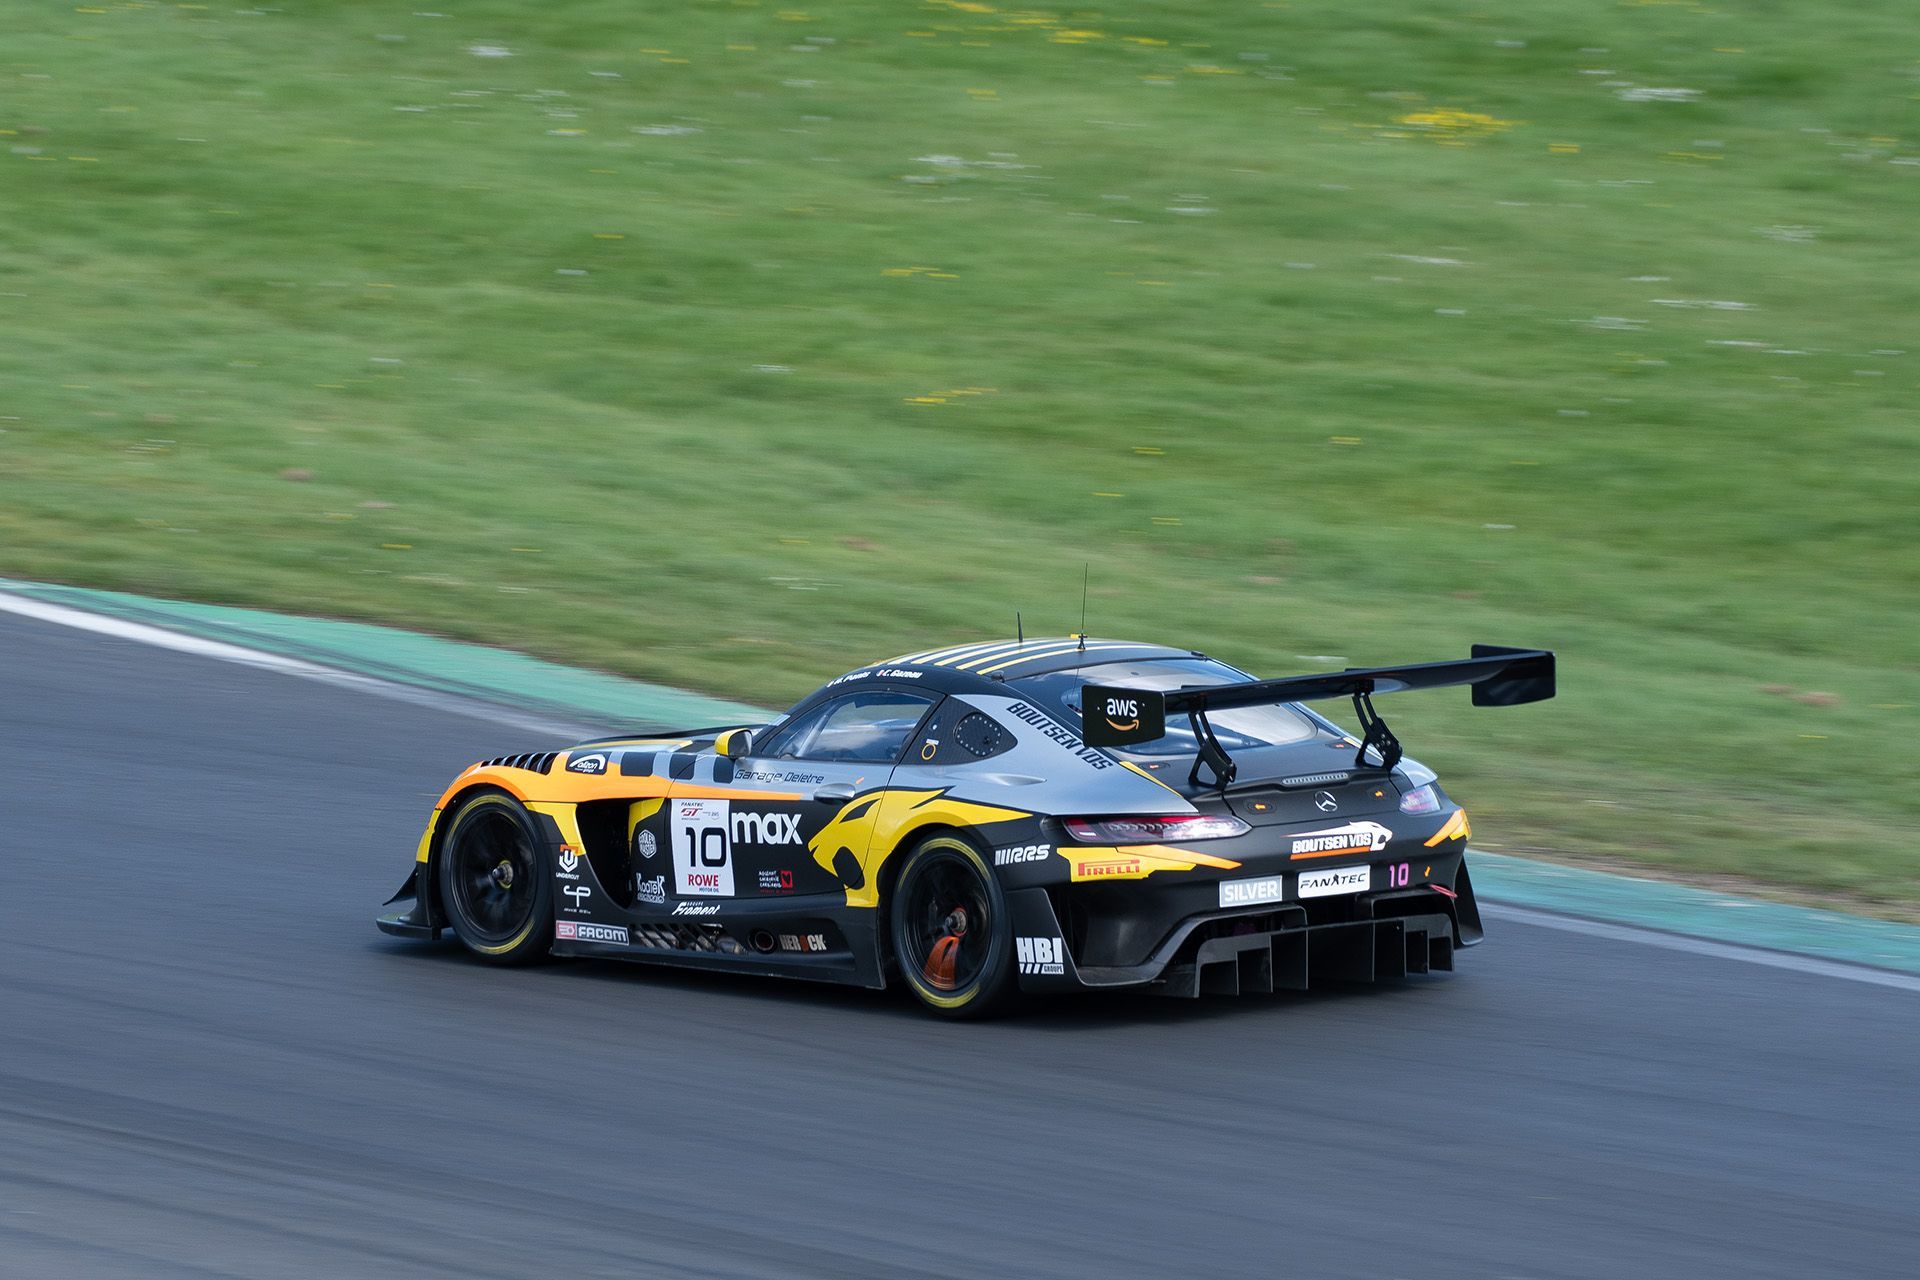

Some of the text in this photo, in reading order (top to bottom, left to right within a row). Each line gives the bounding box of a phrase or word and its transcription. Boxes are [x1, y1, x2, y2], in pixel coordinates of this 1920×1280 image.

[1106, 698, 1138, 717] aws
[1006, 701, 1113, 770] BOUTSEN VDS
[735, 770, 782, 783] Garage
[731, 812, 803, 845] max
[685, 827, 727, 867] 10
[1292, 832, 1373, 854] BOUTSEN VDS
[1078, 859, 1140, 876] PIRELLI
[1389, 863, 1409, 888] 10
[688, 874, 719, 887] ROWE
[1300, 873, 1367, 889] FANATEC
[1224, 880, 1278, 902] SILVER
[671, 902, 721, 916] Froment
[578, 926, 627, 942] FACOM
[779, 934, 827, 951] HEROCK
[1016, 937, 1063, 963] HBI
